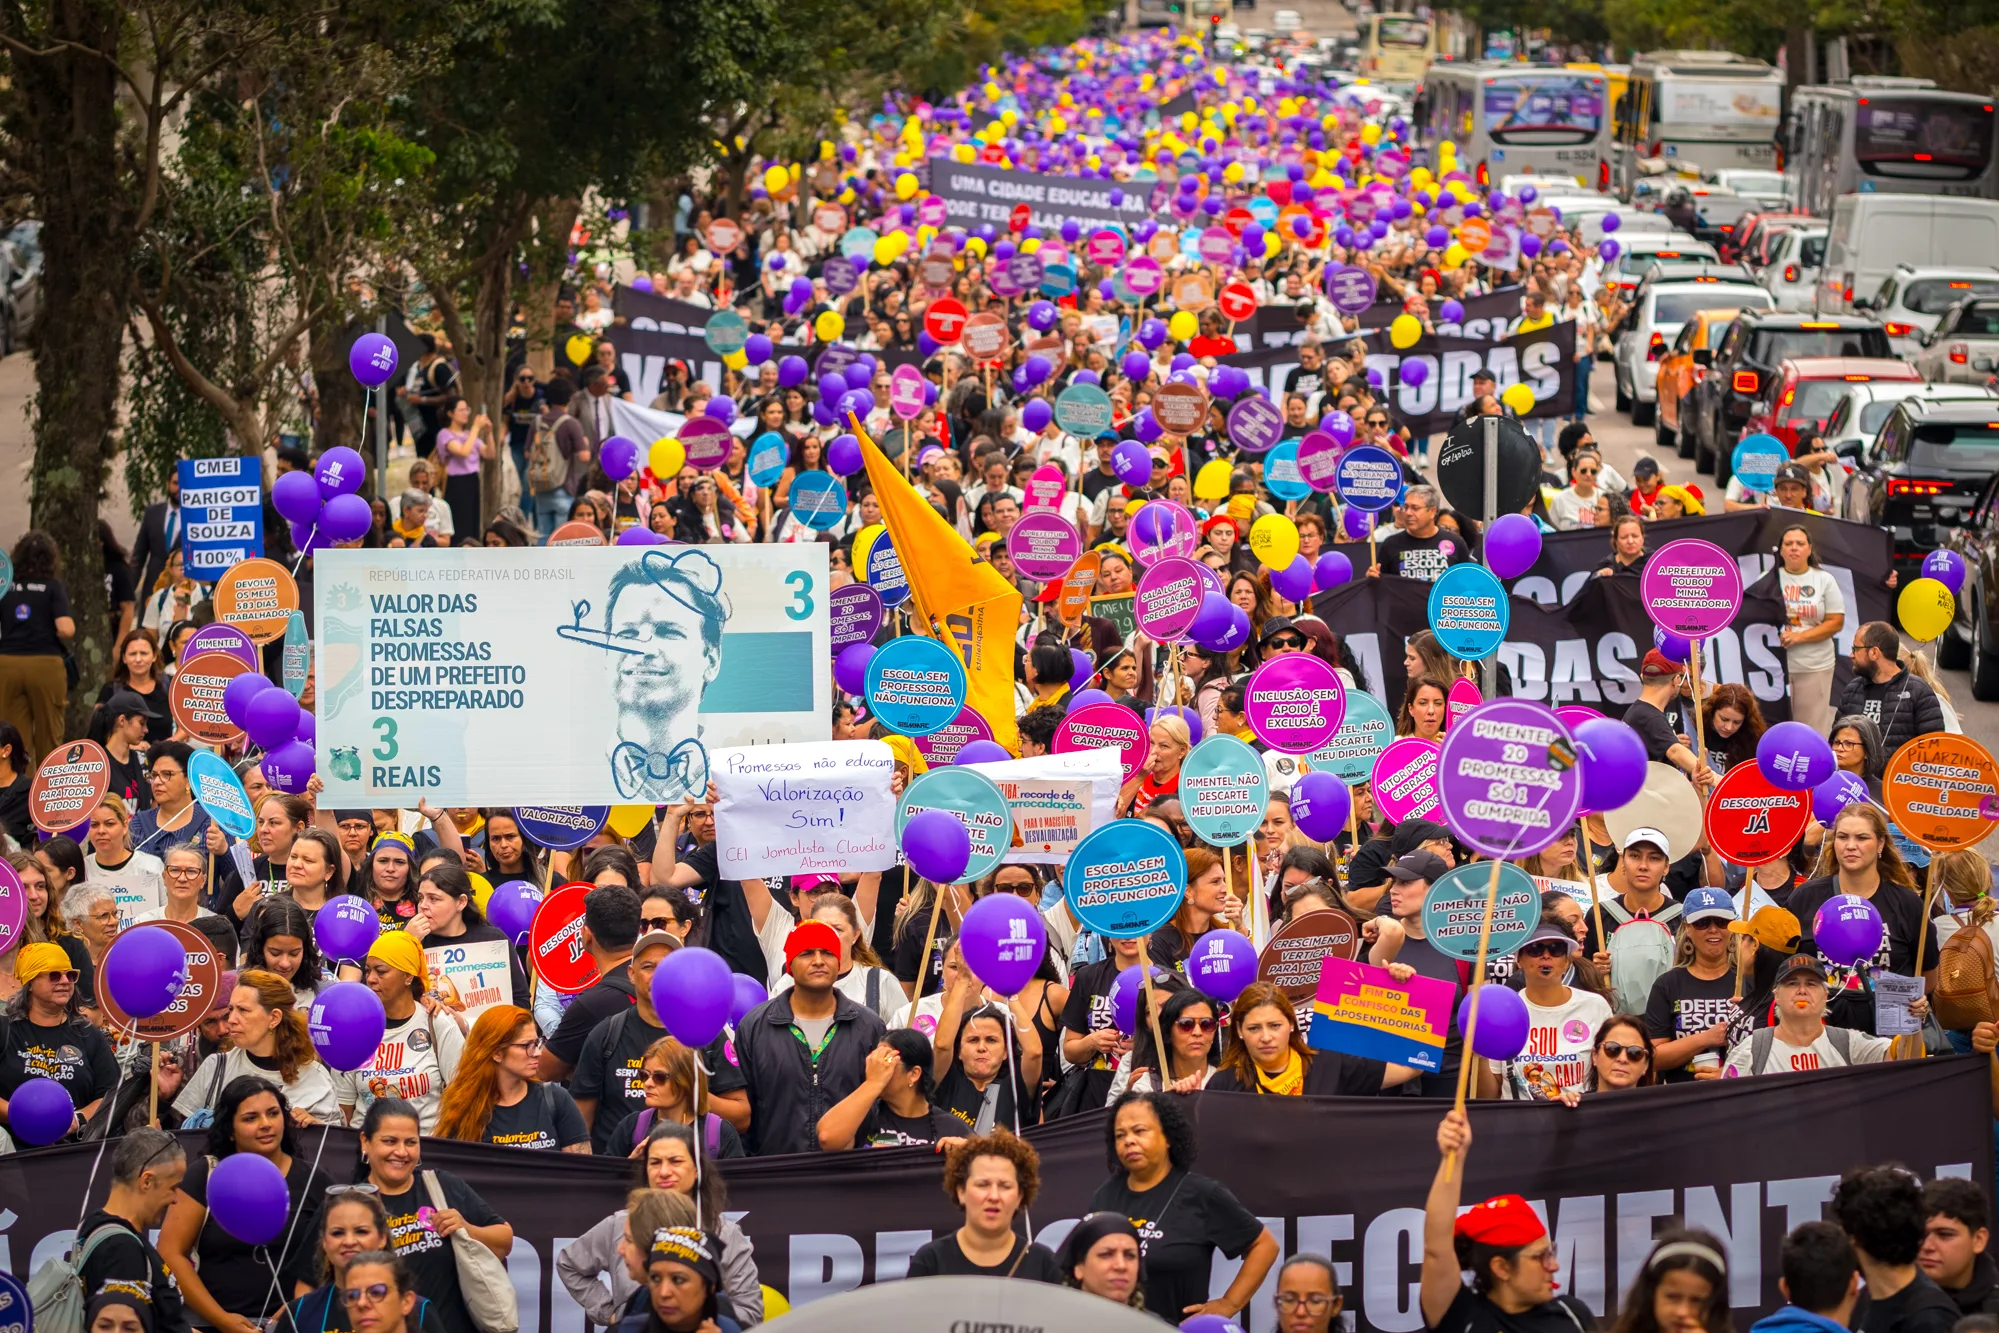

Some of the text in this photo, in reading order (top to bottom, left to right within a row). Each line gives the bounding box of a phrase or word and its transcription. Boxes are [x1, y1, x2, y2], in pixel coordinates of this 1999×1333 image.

[951, 175, 986, 193] UMA
[988, 180, 1045, 201] CIDADE
[980, 204, 1010, 221] TER
[197, 461, 239, 474] CMEI
[183, 490, 257, 504] PARIGOT
[1344, 489, 1395, 498] VALORIZAÇÃO
[208, 508, 231, 520] DE
[190, 525, 251, 539] SOUZA
[195, 551, 241, 565] 100%
[1405, 549, 1447, 560] DEFESA
[1405, 560, 1448, 568] ESCOLA
[1659, 566, 1724, 576] A PREFEITURA
[369, 567, 575, 582] REPÚBLICA FEDERATIVA DO BRASIL
[1672, 577, 1712, 586] ROUBOU
[236, 578, 275, 588] DEVOLVA
[1142, 578, 1196, 601] SALA LOTADA,
[237, 589, 276, 599] OS MEUS
[785, 570, 814, 620] 3
[1149, 589, 1191, 610] EDUCAÇÃO
[1677, 589, 1707, 598] MINHA
[237, 600, 277, 610] 583 DIAS
[370, 594, 477, 614] VALOR DAS
[1443, 596, 1494, 606] ESCOLA SEM
[1652, 598, 1731, 608] APOSENTADORIA
[224, 610, 291, 622] TRABALHADOS
[842, 606, 853, 614] 20
[1144, 599, 1197, 623] PRECARIZADA
[1441, 608, 1496, 618] PROFESSORA
[371, 619, 443, 637] FALSAS
[835, 624, 848, 633] SÓ
[1438, 618, 1501, 630] NÃO FUNCIONA
[198, 639, 242, 648] PIMENTEL:
[371, 643, 491, 661] PROMESSAS
[371, 666, 526, 685] DE UM PREFEITO
[882, 670, 948, 682] ESCOLA SEM
[880, 682, 950, 694] PROFESSORA
[1254, 688, 1336, 701] INCLUSÃO SEM
[184, 700, 212, 709] PARA
[372, 689, 524, 710] DESPREPARADO
[874, 692, 955, 706] NÃO FUNCIONA
[1272, 702, 1319, 714] APOIO É
[194, 712, 199, 720] E
[1266, 715, 1326, 728] EXCLUSÃO
[1070, 722, 1138, 739] VITOR PUPPI,
[1360, 720, 1384, 732] NÃO
[372, 716, 399, 761] 3
[1918, 740, 1940, 748] EM
[1314, 747, 1383, 761] MEU DIPLOMA
[1506, 746, 1526, 760] 20
[1908, 748, 1993, 772] PILARZINHO
[42, 762, 103, 776] CRESCIMENTO
[727, 752, 801, 774] Promessas
[814, 758, 836, 768] não
[372, 766, 441, 788] REAIS
[1380, 752, 1436, 793] VITOR PUPPI,
[1912, 763, 1980, 779] CONFISCAR
[49, 776, 89, 786] VERTICAL
[1187, 774, 1260, 788] PIMENTEL, NÃO
[1894, 773, 1995, 794] APOSENTADORIA
[40, 786, 94, 800] PARA TODAS
[758, 778, 863, 803] Valorização
[1020, 790, 1075, 800] recorde de
[1199, 790, 1248, 801] DESCARTE
[1414, 784, 1433, 802] DOS
[1491, 784, 1514, 799] SÓ
[1940, 791, 1949, 802] É
[45, 799, 82, 811] E TODOS
[1721, 796, 1800, 808] DESCONGELA,
[1192, 804, 1258, 816] MEU DIPLOMA
[1467, 803, 1549, 823] CUMPRIDA
[1908, 802, 1978, 818] CRUELDADE
[520, 808, 595, 830] VALORIZAÇÃO
[785, 808, 844, 828] Sim!
[975, 814, 1003, 826] NÃO
[1024, 815, 1077, 829] PARA O MAGISTÉRIO:
[1744, 811, 1768, 833] JÁ
[1025, 827, 1078, 844] DESVALORIZAÇÃO
[726, 837, 885, 861] CEI Jornalista Claudio
[1085, 856, 1164, 877] ESCOLA SEM
[1083, 872, 1169, 891] PROFESSORA
[1079, 884, 1177, 906] NÃO FUNCIONA
[1551, 882, 1587, 896] lotadas,
[1433, 894, 1530, 912] PIMENTE, NÃO
[1702, 892, 1714, 906] LA
[1009, 918, 1028, 939] SOU
[1438, 926, 1464, 937] MEU
[1209, 939, 1224, 954] SOU
[1274, 934, 1350, 949] CRESCIMENTO
[444, 948, 465, 964] 20
[1282, 949, 1333, 961] VERTICAL
[445, 960, 506, 975] promessas
[1268, 964, 1298, 975] PARA
[470, 972, 485, 990] só 1
[1275, 974, 1320, 985] E TODOS
[465, 987, 502, 1008] CUMPRIDA
[1364, 988, 1402, 1000] FIM DO
[1344, 997, 1421, 1017] CONFISCO DAS
[1334, 1009, 1427, 1032] APOSENTADORIAS
[1530, 1027, 1557, 1055] SOU
[376, 1042, 404, 1070] SOU
[492, 1130, 547, 1145] valorizar O
